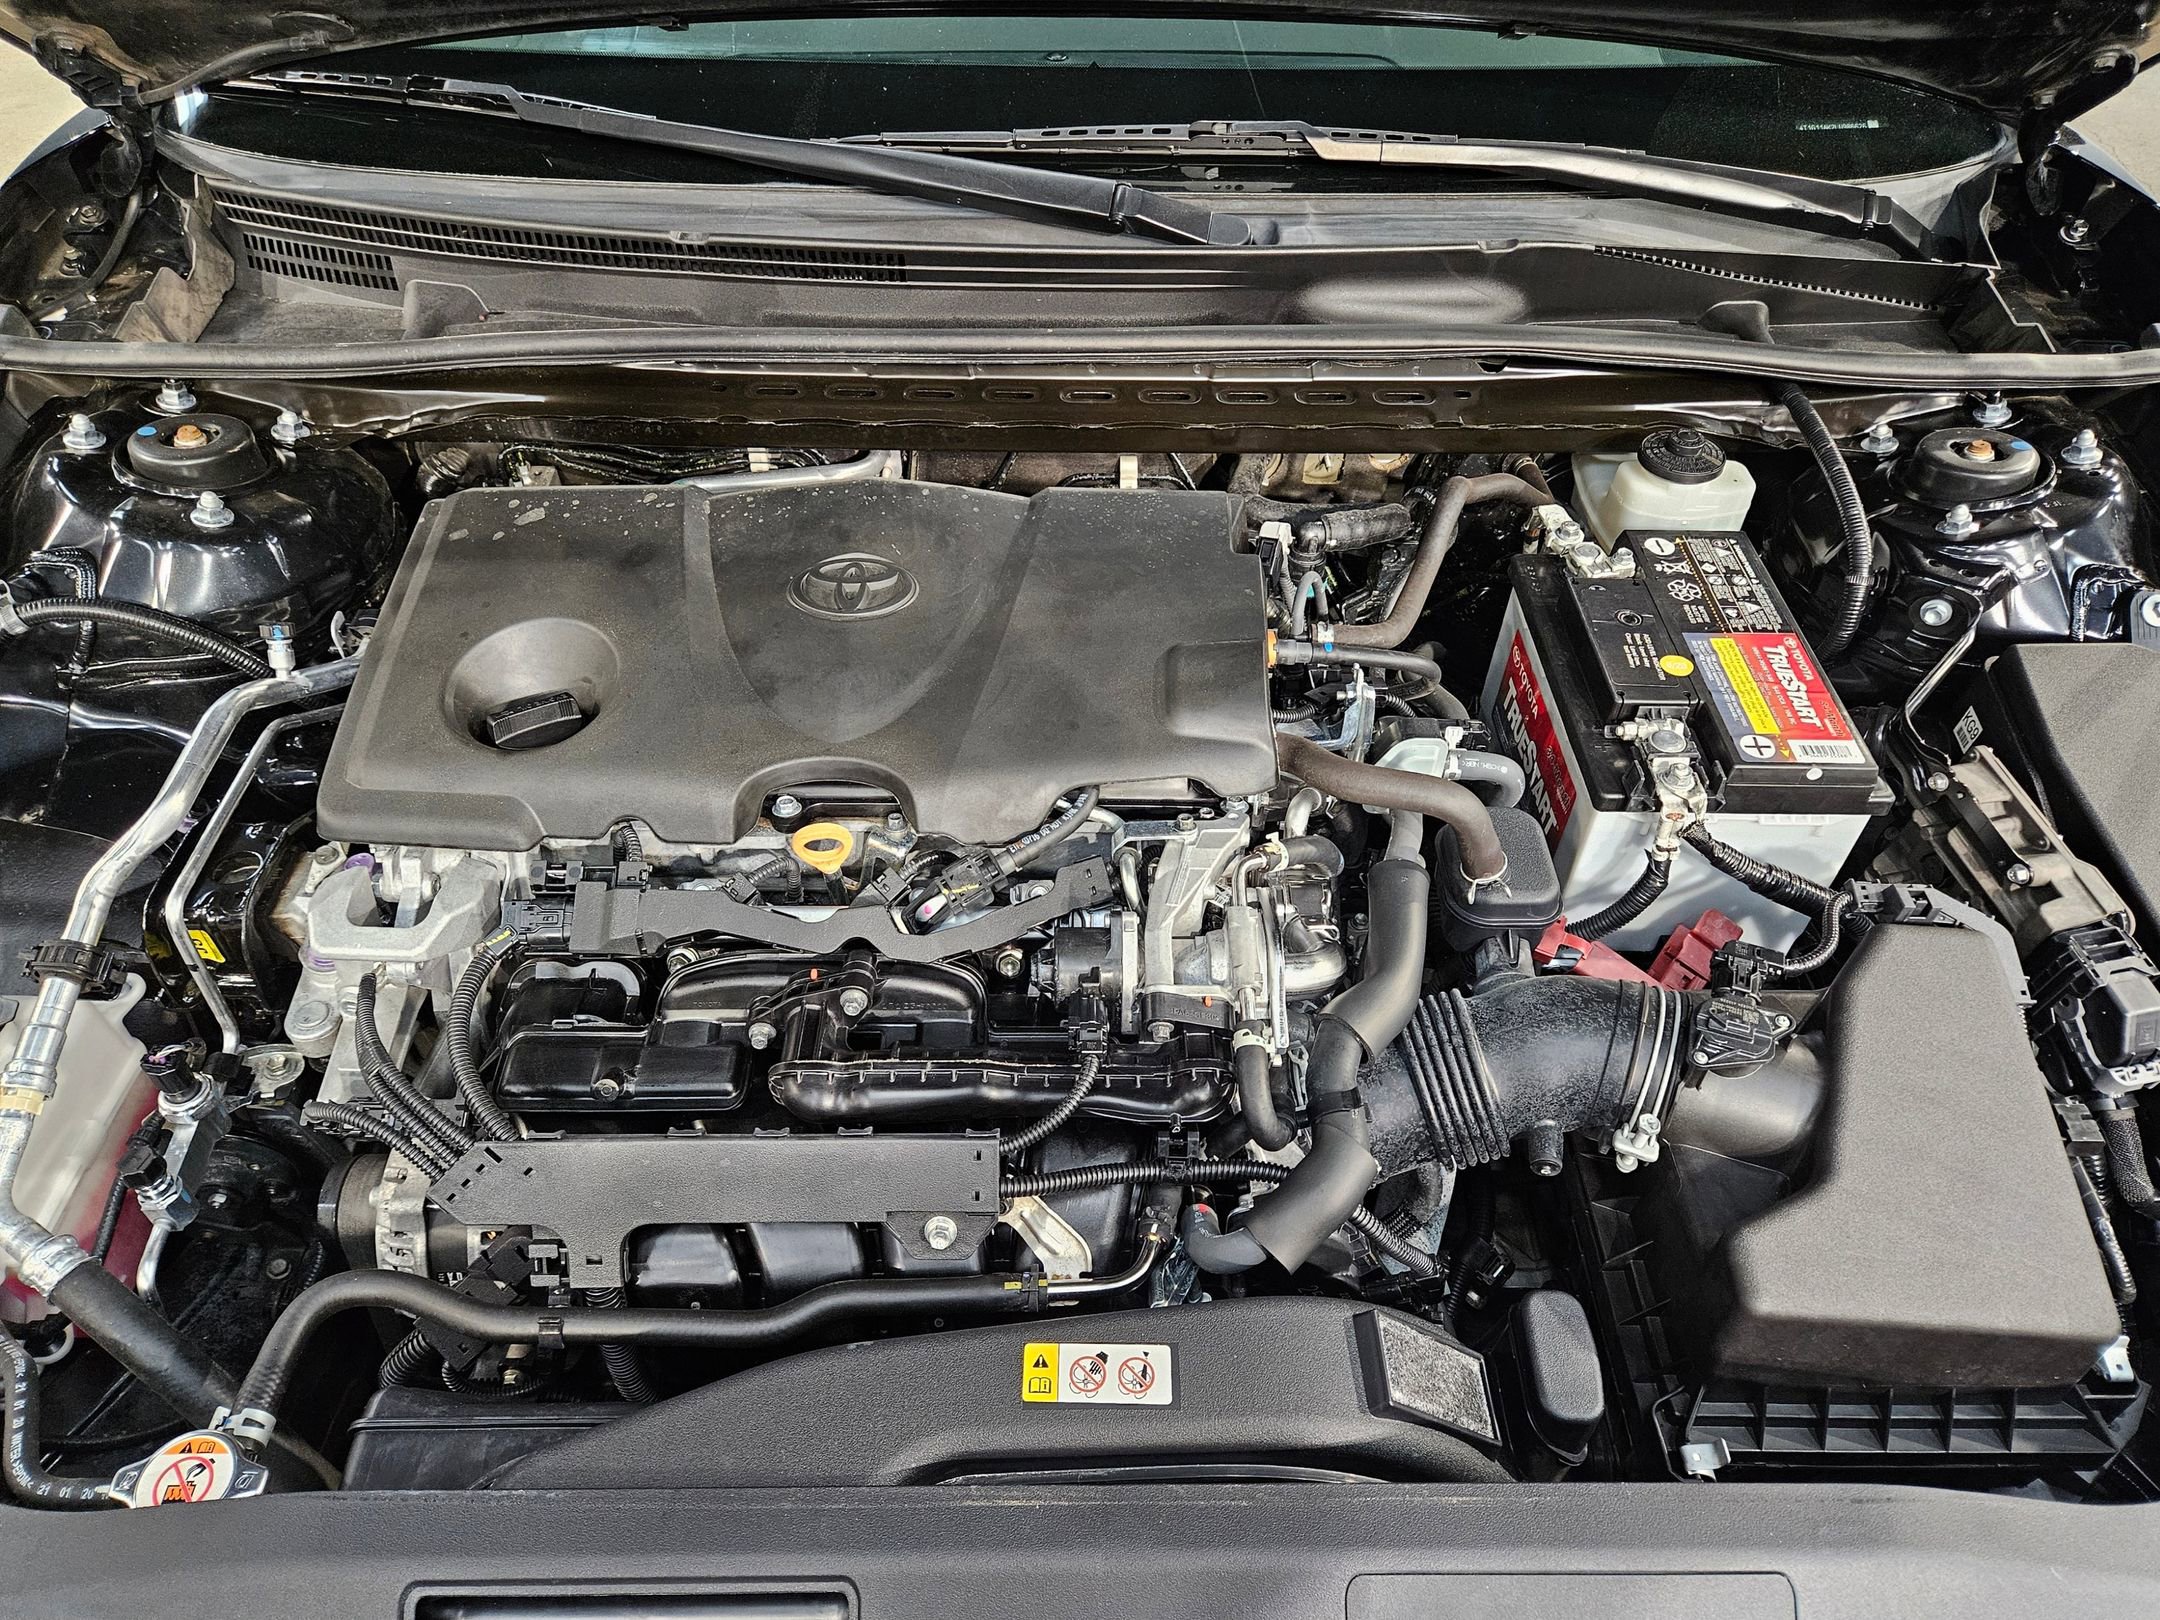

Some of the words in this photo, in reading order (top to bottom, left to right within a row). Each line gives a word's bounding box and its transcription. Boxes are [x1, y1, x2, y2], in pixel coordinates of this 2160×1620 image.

[1790, 648, 1814, 681] TOYOTA
[1518, 665, 1539, 720] TOYOTA
[1962, 711, 1980, 740] KG9
[15, 1383, 26, 1393] 21
[13, 1400, 26, 1411] 01
[12, 1416, 24, 1429] 20
[37, 1483, 51, 1496] 21
[59, 1486, 73, 1499] 01
[80, 1488, 95, 1499] 20
